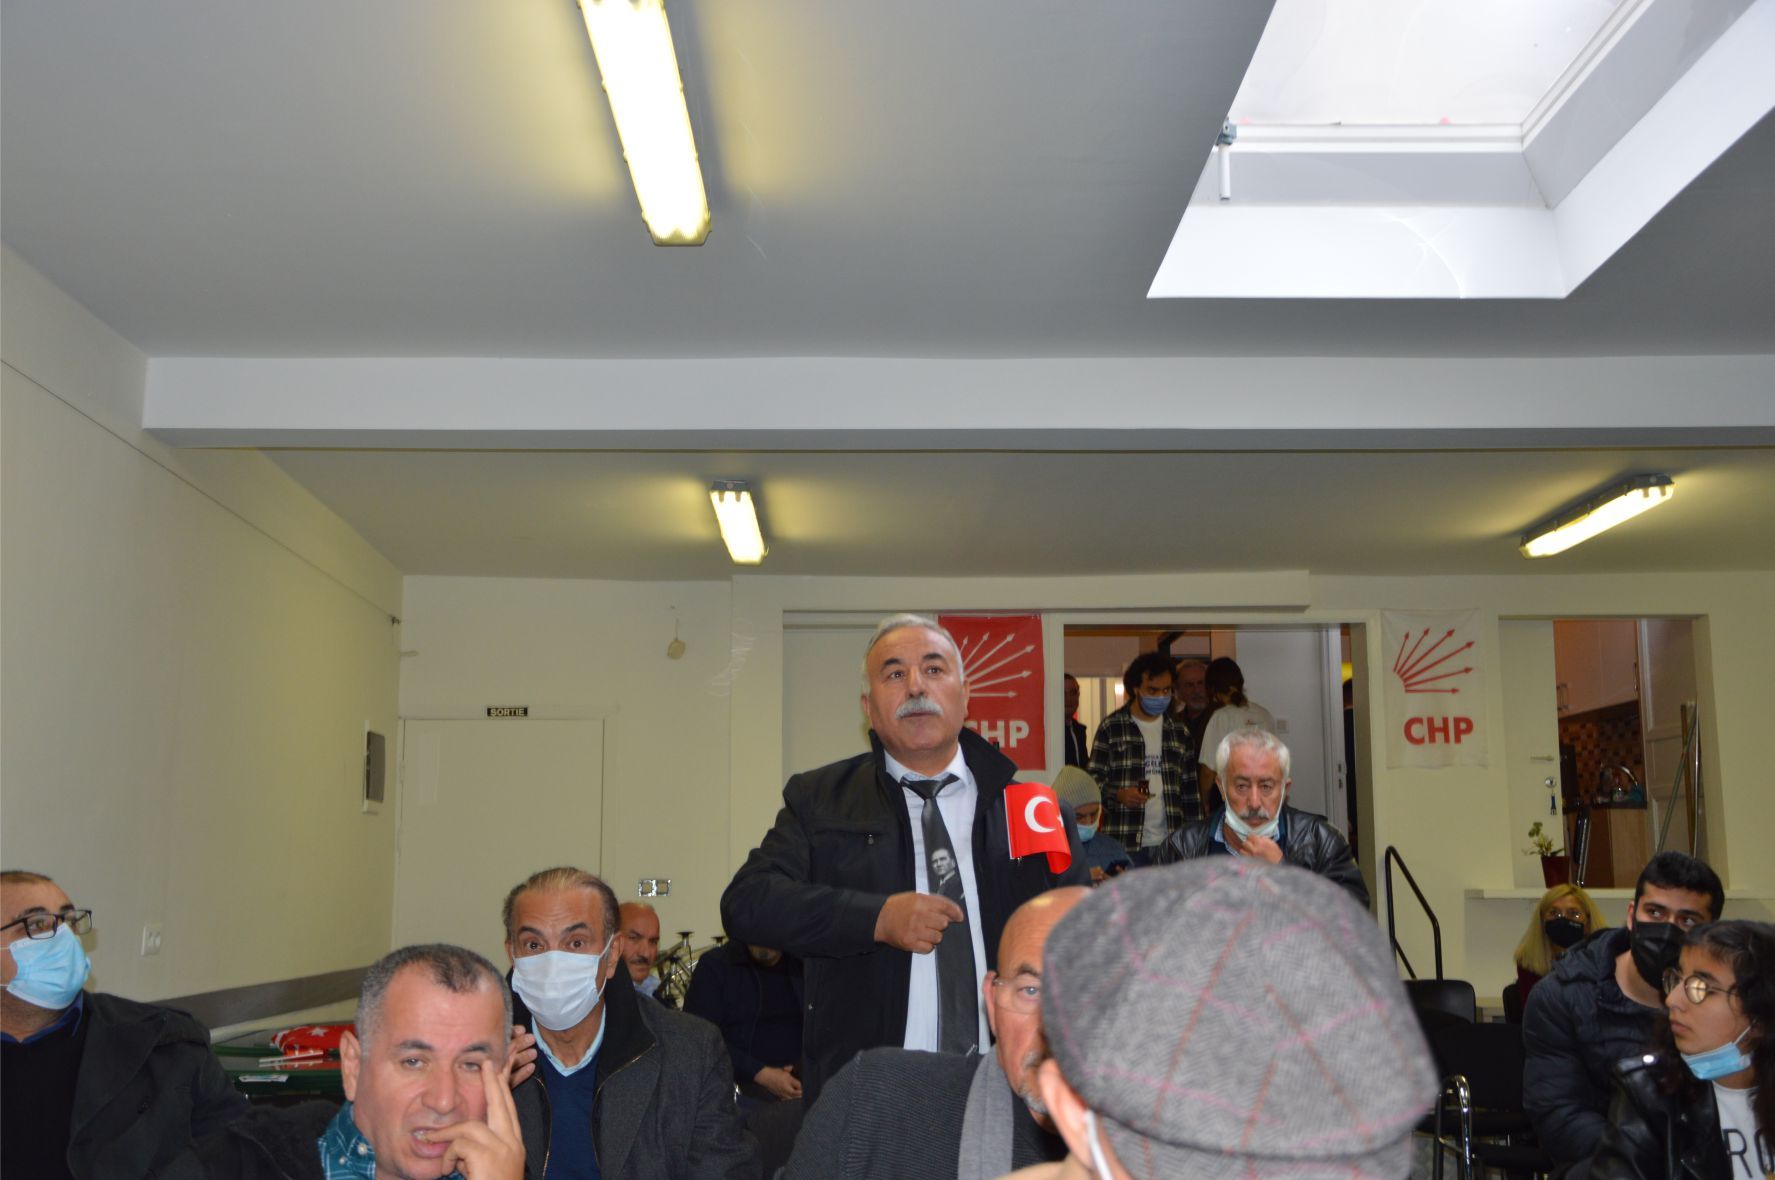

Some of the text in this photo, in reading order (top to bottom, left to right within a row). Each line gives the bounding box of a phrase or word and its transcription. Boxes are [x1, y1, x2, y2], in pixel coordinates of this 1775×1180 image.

[490, 708, 525, 717] SORTIE
[963, 719, 1030, 748] HP
[1403, 716, 1474, 746] CHP
